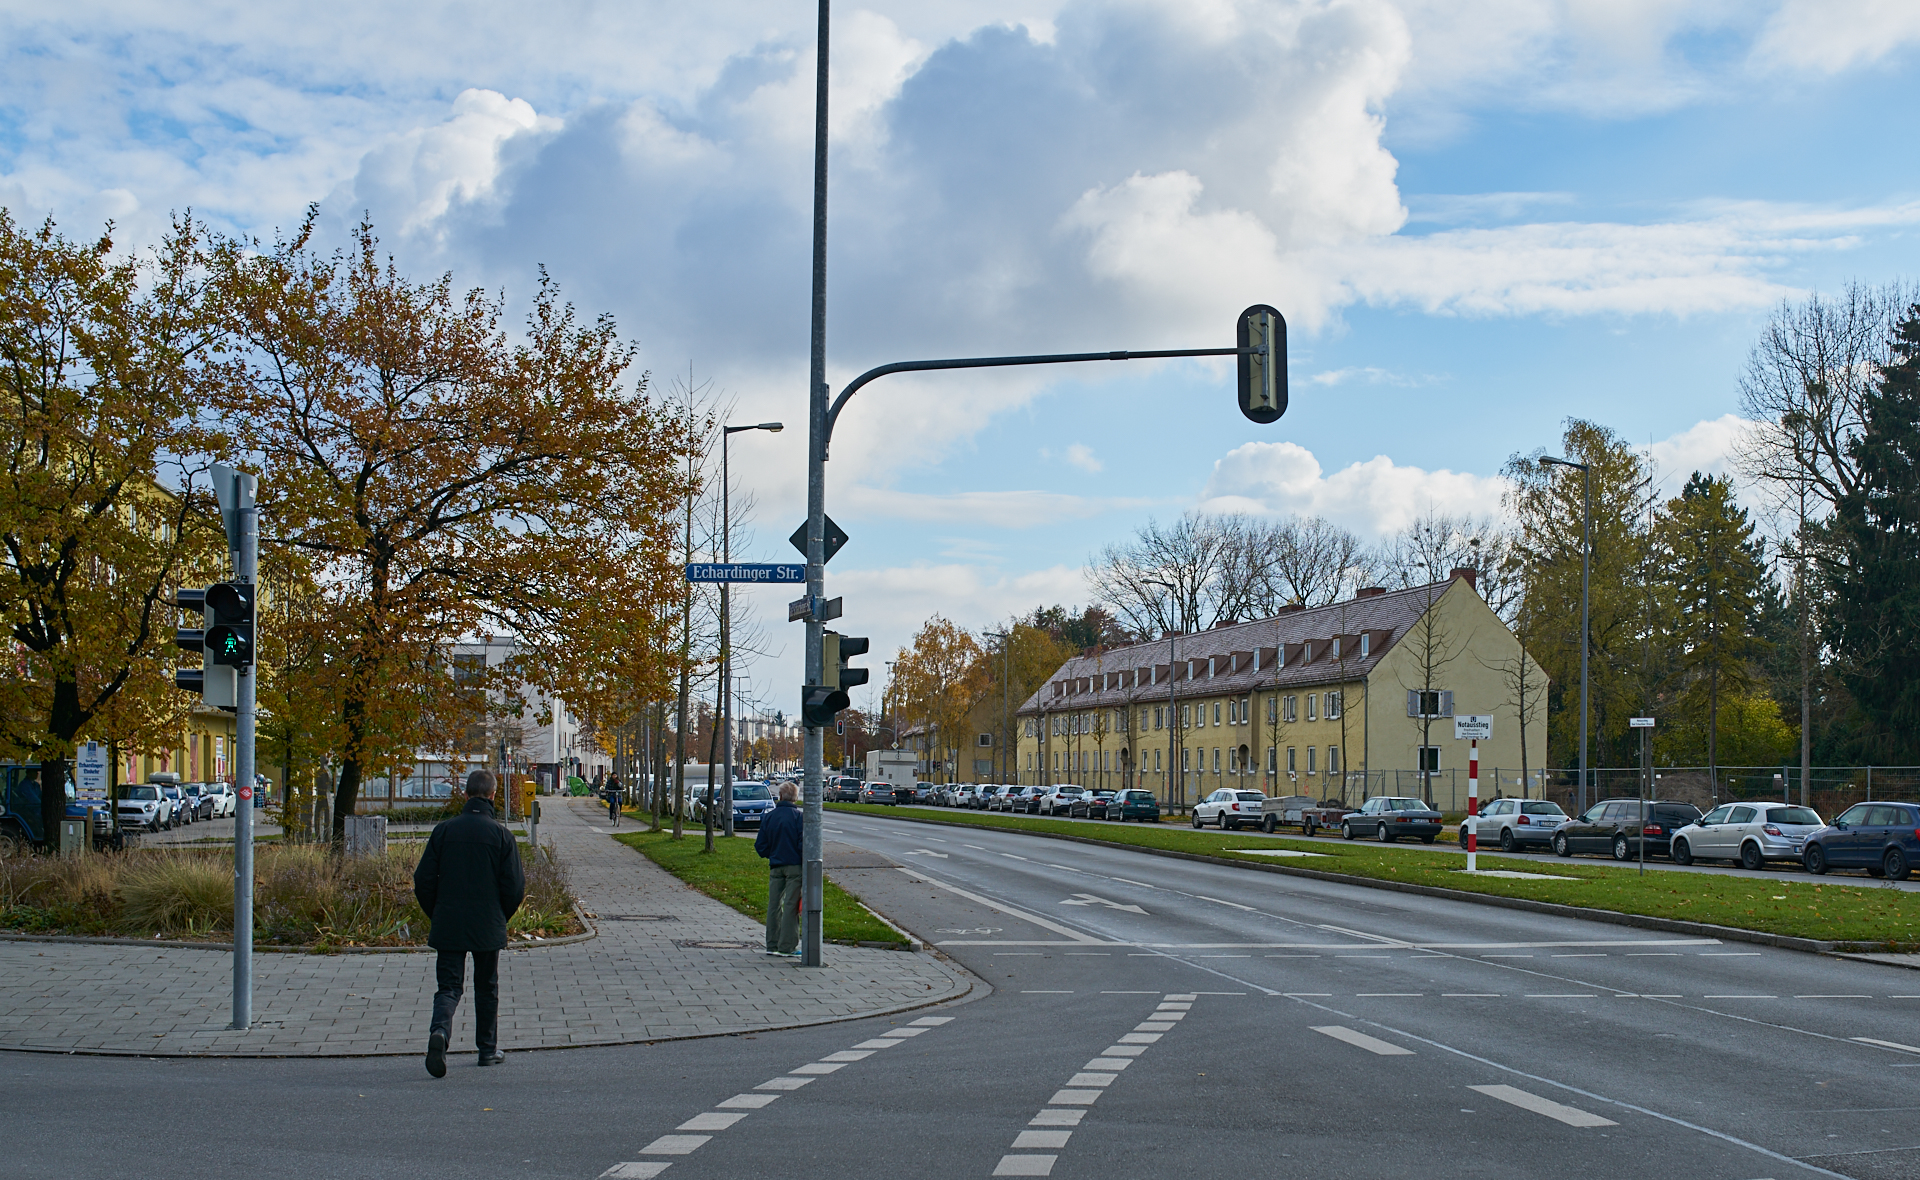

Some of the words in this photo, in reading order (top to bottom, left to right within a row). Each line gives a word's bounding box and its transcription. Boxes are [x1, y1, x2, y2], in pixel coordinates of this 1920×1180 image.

[693, 565, 772, 581] Echardinger
[776, 565, 799, 579] Str.
[1457, 721, 1489, 729] Notausstieg
